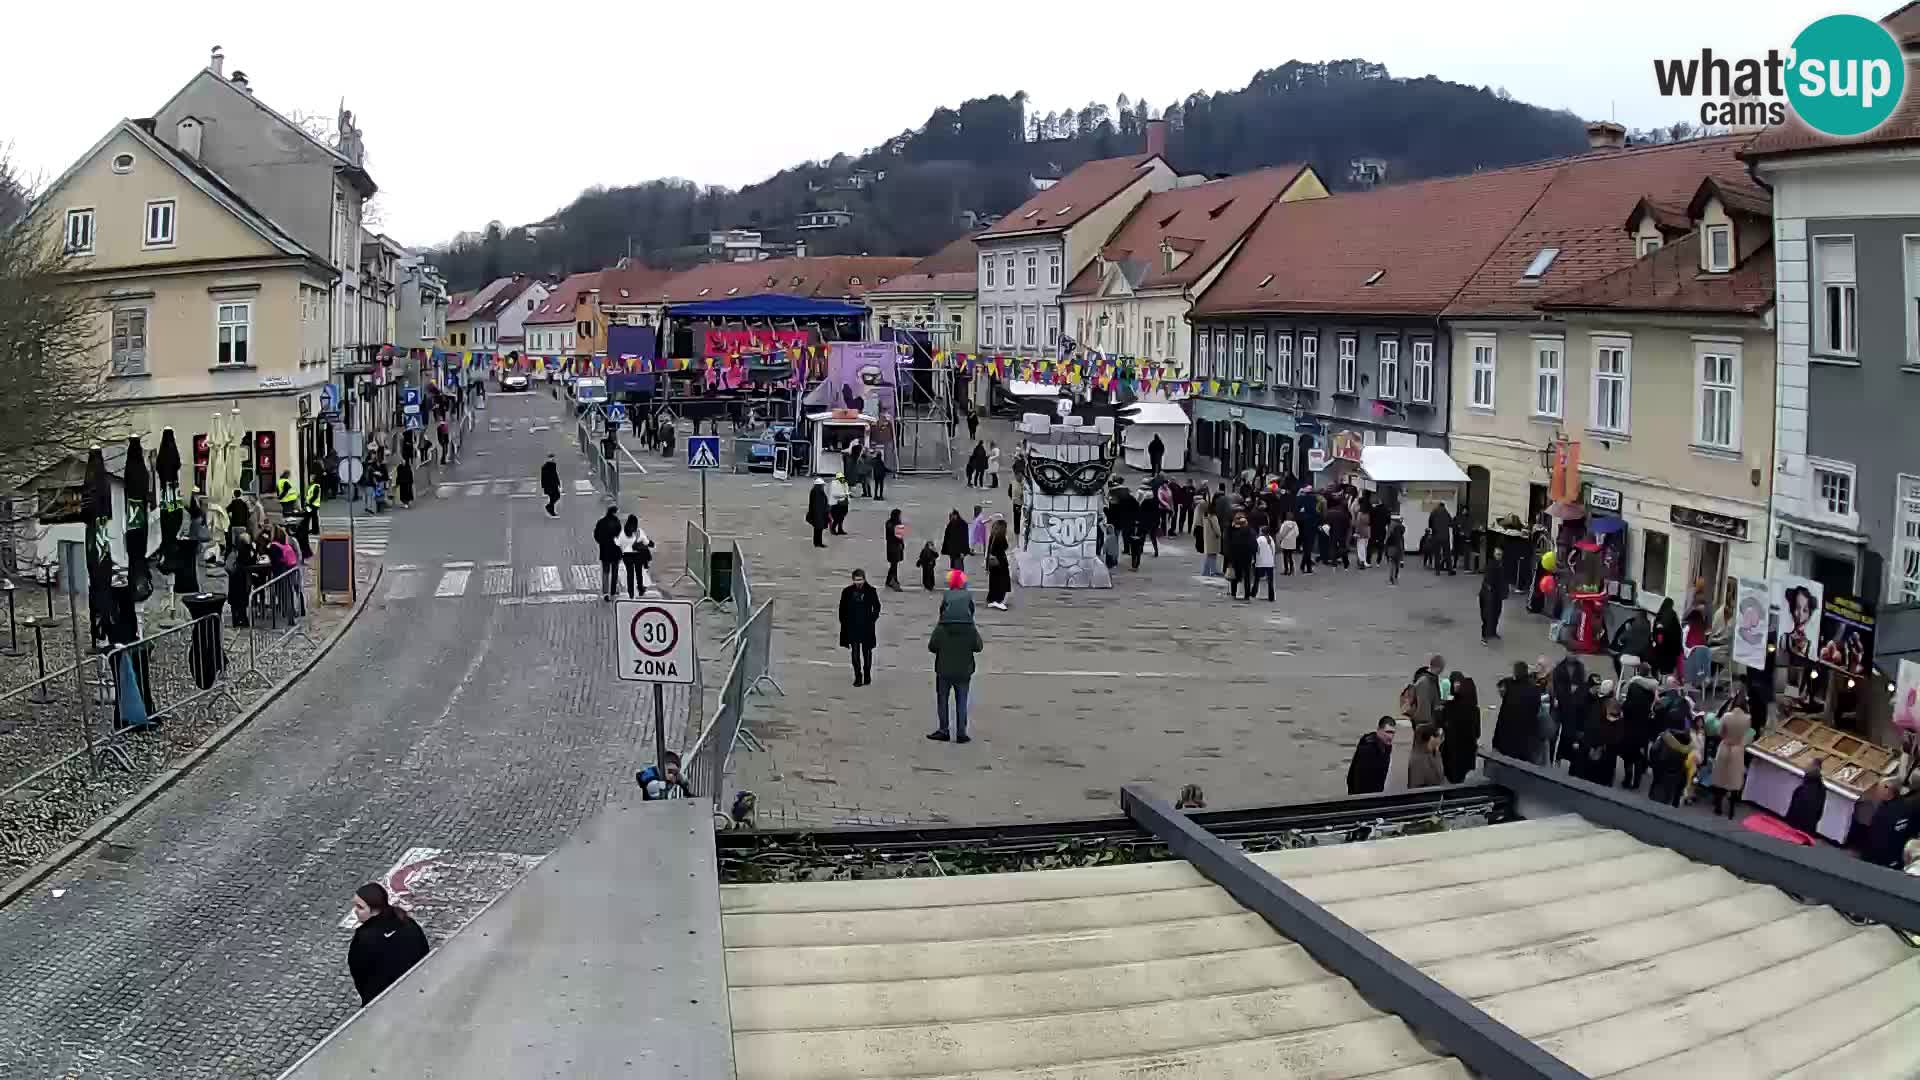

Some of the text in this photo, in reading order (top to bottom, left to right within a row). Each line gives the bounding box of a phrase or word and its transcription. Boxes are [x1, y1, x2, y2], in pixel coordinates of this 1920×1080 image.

[407, 392, 416, 402] P
[1048, 516, 1087, 545] 200
[643, 622, 667, 643] 30
[633, 660, 678, 676] ZONA
